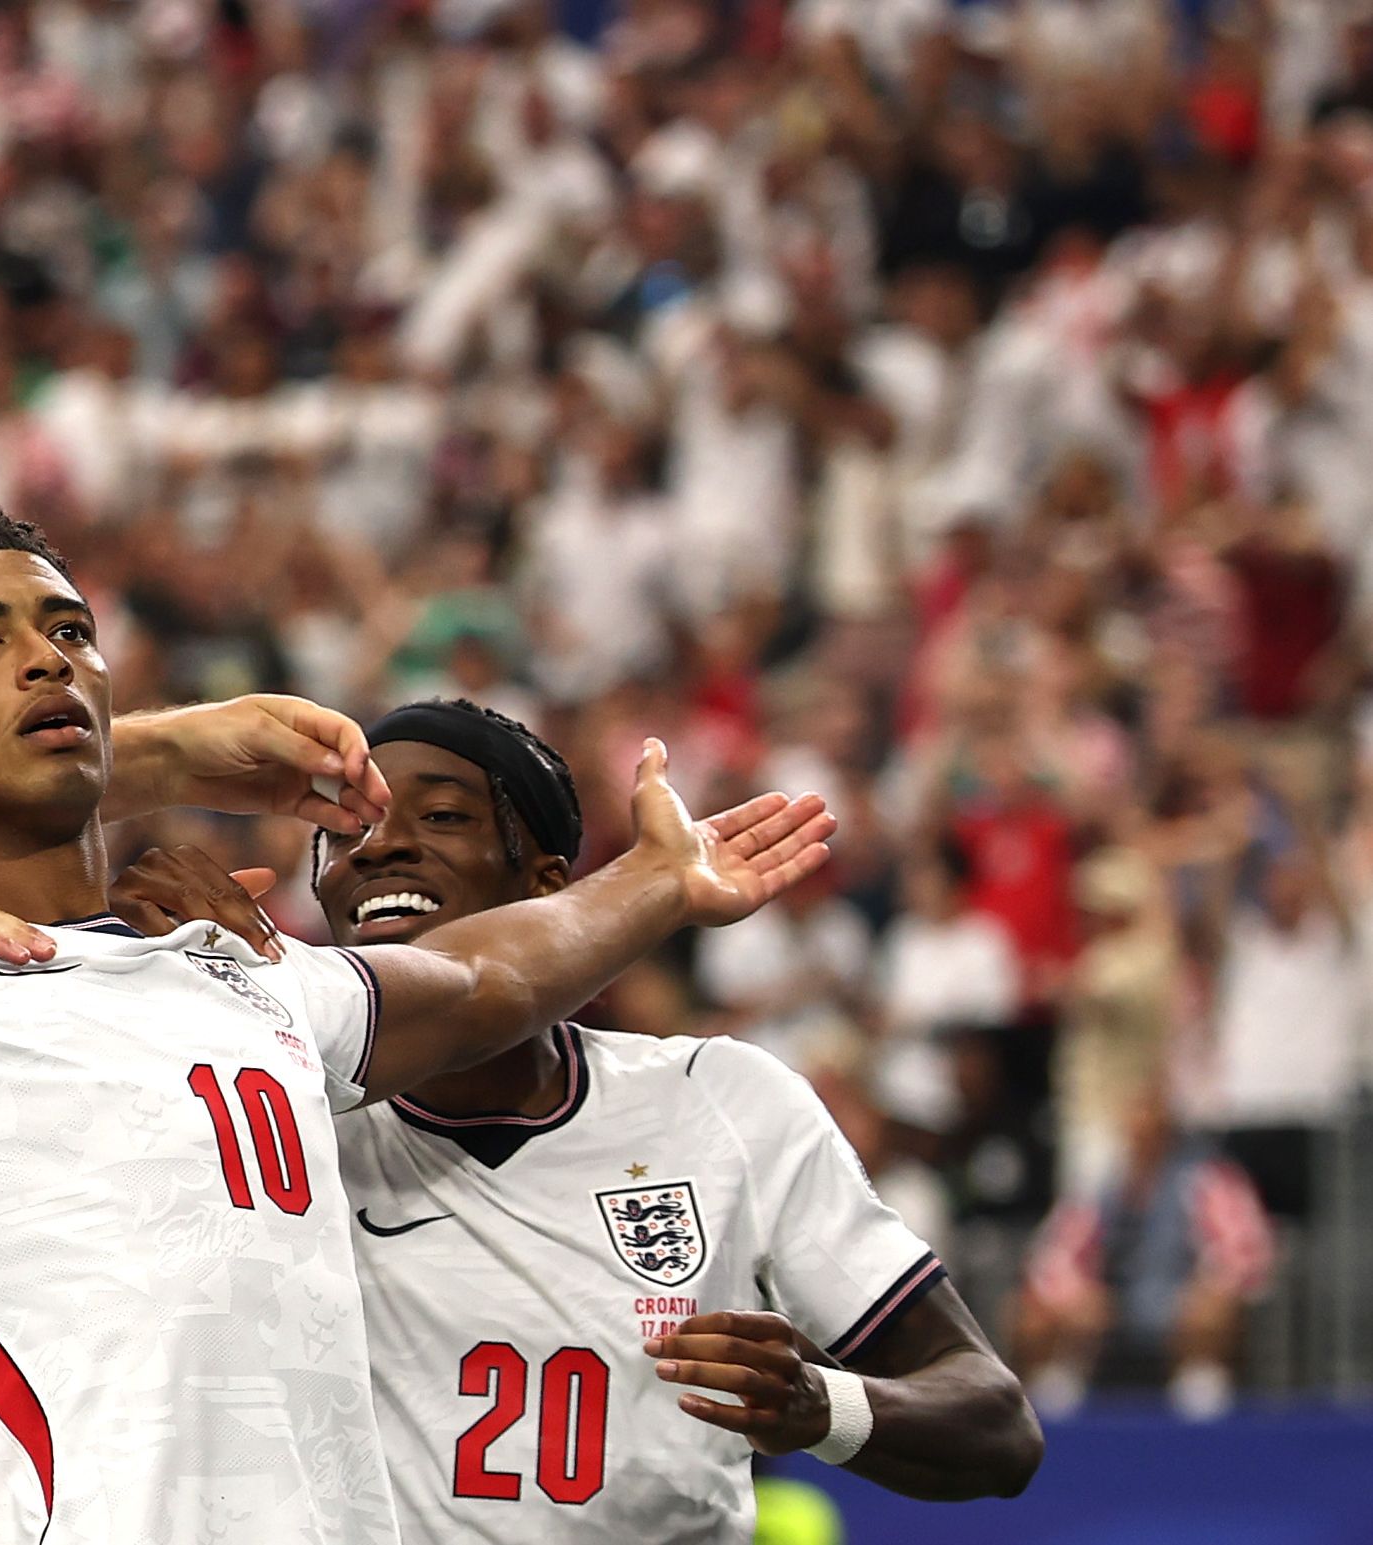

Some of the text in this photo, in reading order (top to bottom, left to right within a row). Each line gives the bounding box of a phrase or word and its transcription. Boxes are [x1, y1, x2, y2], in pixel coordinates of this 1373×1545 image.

[187, 1063, 312, 1217] 10
[635, 1297, 697, 1315] CROATIA
[453, 1341, 609, 1505] 20
